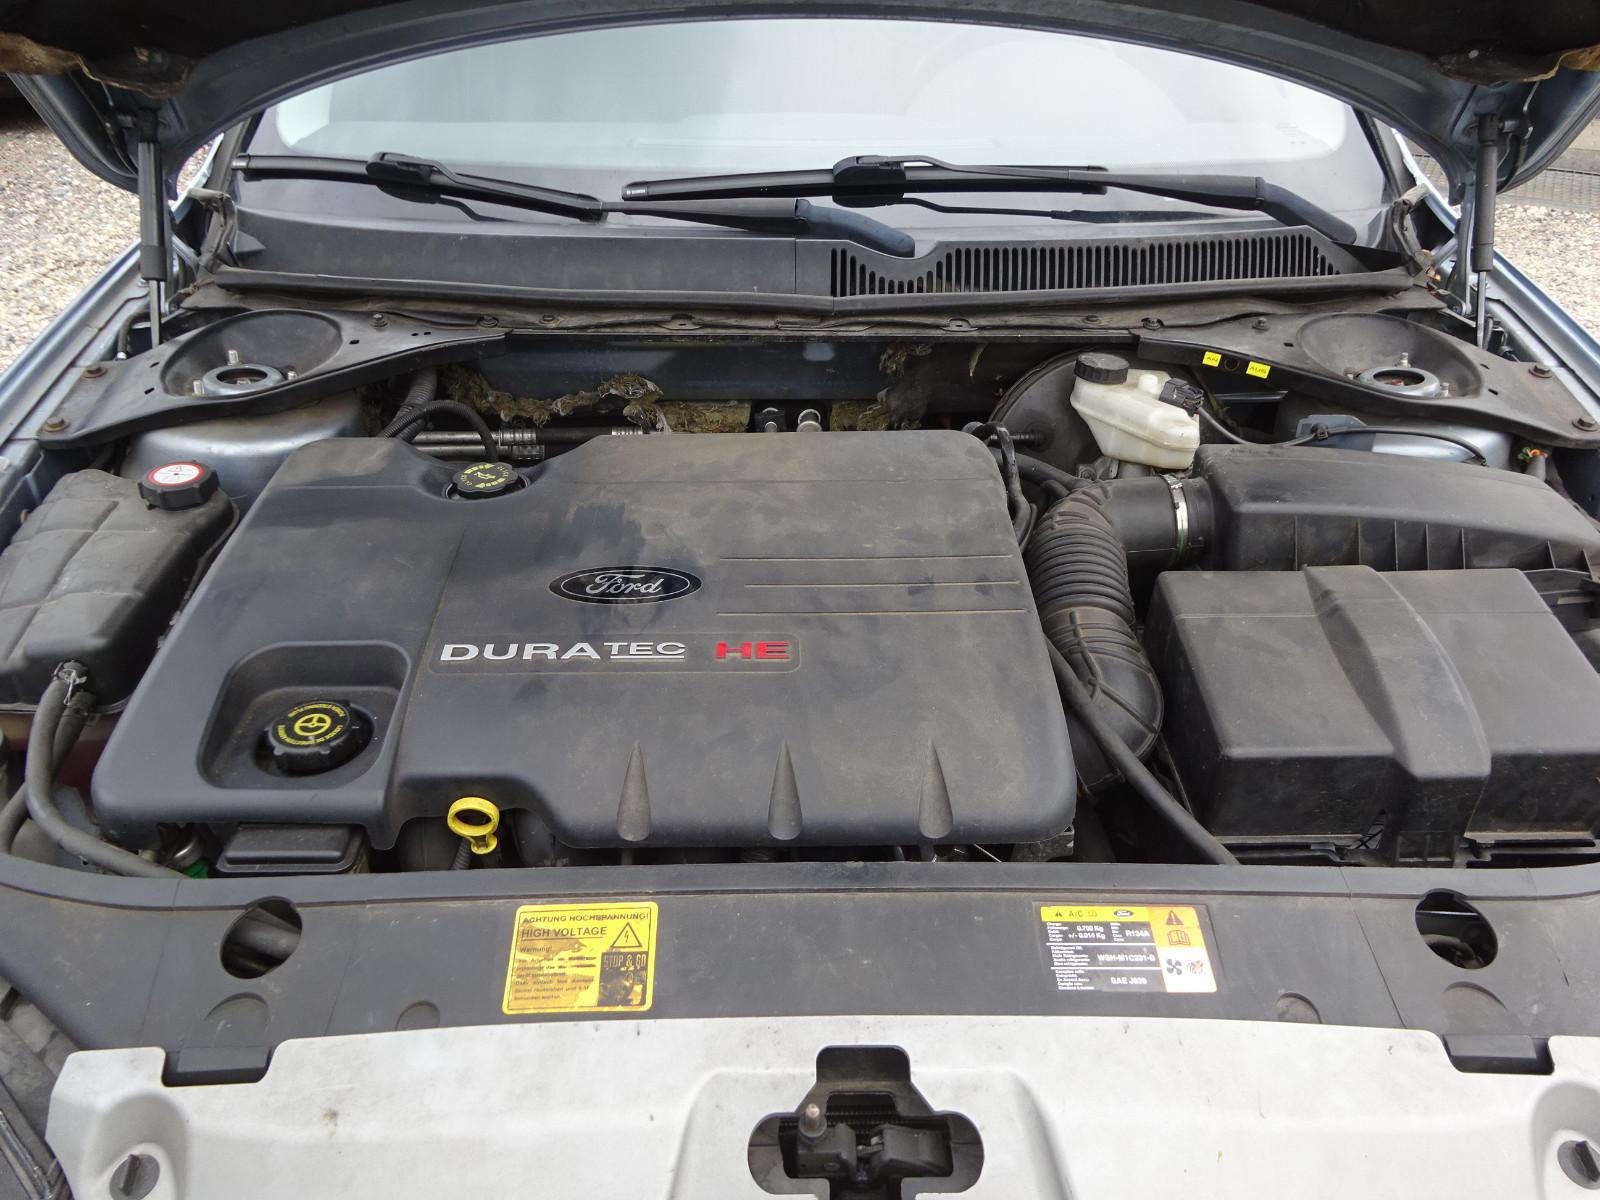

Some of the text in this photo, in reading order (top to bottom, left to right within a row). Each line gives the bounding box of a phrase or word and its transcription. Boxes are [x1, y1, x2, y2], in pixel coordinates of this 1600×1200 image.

[585, 573, 664, 595] Ford
[440, 641, 791, 661] DURATEC HE
[523, 912, 649, 924] ACHTUNG HOCHSPANNUNG!
[1068, 910, 1084, 918] A/C
[521, 926, 608, 938] HIGH VOLTAGE
[1125, 929, 1151, 938] R134A
[603, 954, 624, 968] STOP
[636, 953, 647, 968] GO
